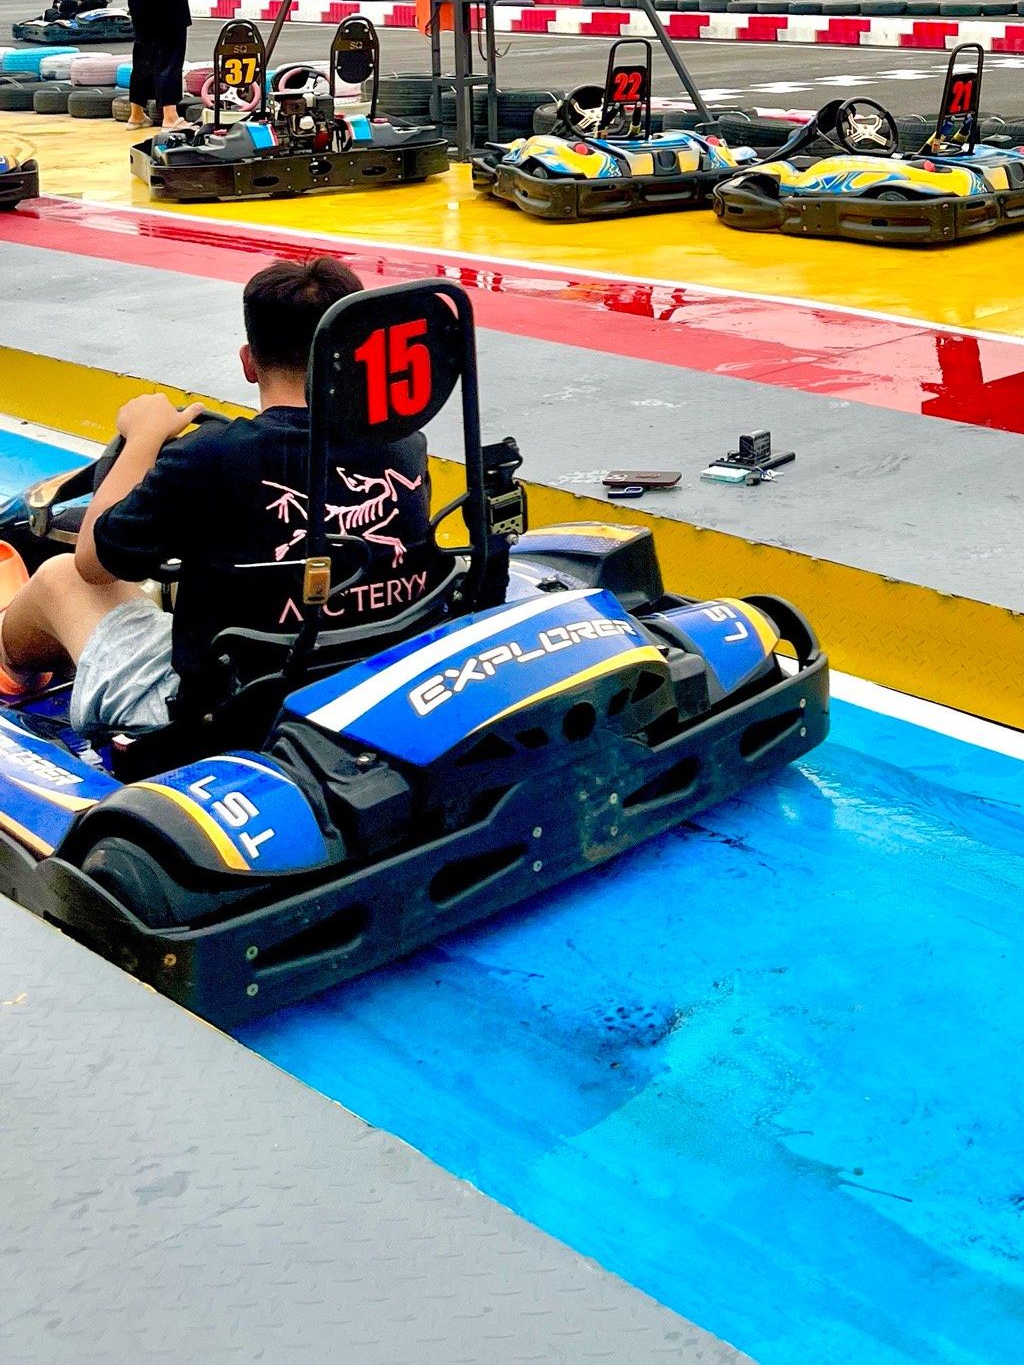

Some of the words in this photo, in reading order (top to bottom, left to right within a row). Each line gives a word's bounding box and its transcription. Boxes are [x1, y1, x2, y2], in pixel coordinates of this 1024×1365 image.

[225, 57, 257, 85] 37
[613, 72, 642, 101] 22
[950, 80, 973, 113] 21
[354, 318, 432, 425] 15
[408, 619, 637, 716] EXPLORER
